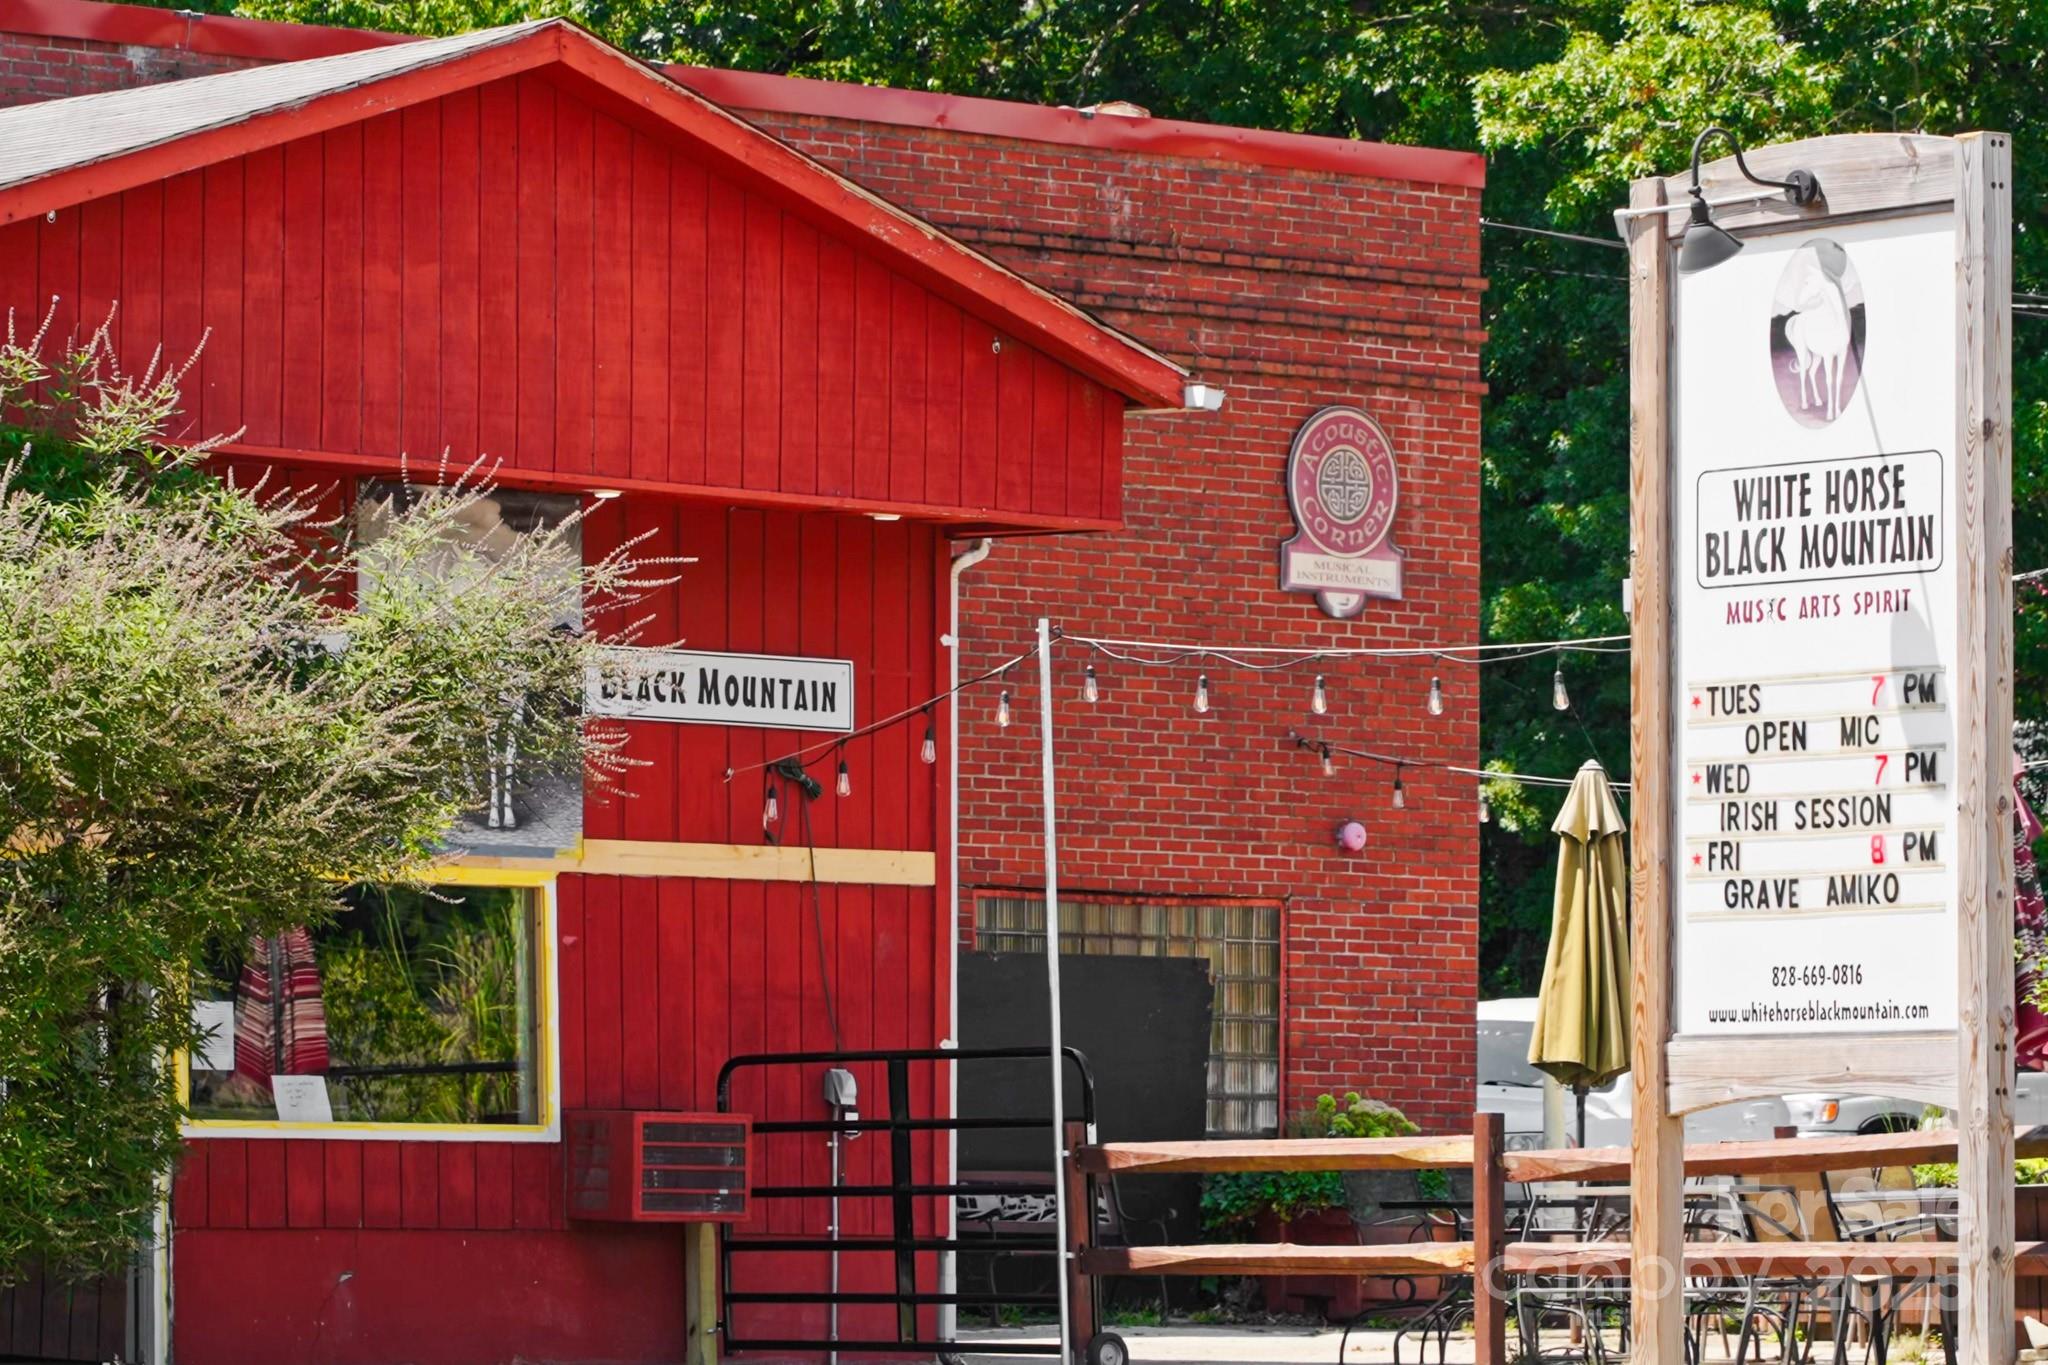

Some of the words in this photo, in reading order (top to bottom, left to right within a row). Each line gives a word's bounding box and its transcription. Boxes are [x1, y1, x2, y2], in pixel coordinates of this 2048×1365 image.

[1733, 472, 1812, 522] WHITE
[1825, 464, 1906, 515] HORSE
[1705, 526, 1787, 578] BLACK
[1799, 514, 1934, 570] MOUNTAIN
[1295, 570, 1392, 587] INSTRUMENTS
[1799, 594, 1841, 619] ARTS
[1853, 588, 1912, 616] SPIRIT
[1706, 684, 1761, 716] TUES
[1871, 675, 1886, 706] 7
[1903, 673, 1937, 704] PM
[1745, 720, 1807, 754] OPEN
[1840, 715, 1880, 748] MIC
[1706, 764, 1750, 794] WED
[1874, 755, 1889, 785] 7
[1904, 752, 1937, 782] PM
[1720, 801, 1778, 832] IRISH
[1794, 793, 1892, 830] SESSION
[1707, 840, 1741, 872] FRI
[1870, 834, 1884, 864] 8
[1903, 830, 1937, 862] PM
[1724, 878, 1800, 909] GRAVE
[1826, 872, 1900, 907] AMIKO
[1772, 964, 1864, 987] 828-669-0816
[1708, 999, 1930, 1024] www.whitehorseblackmountain.com
